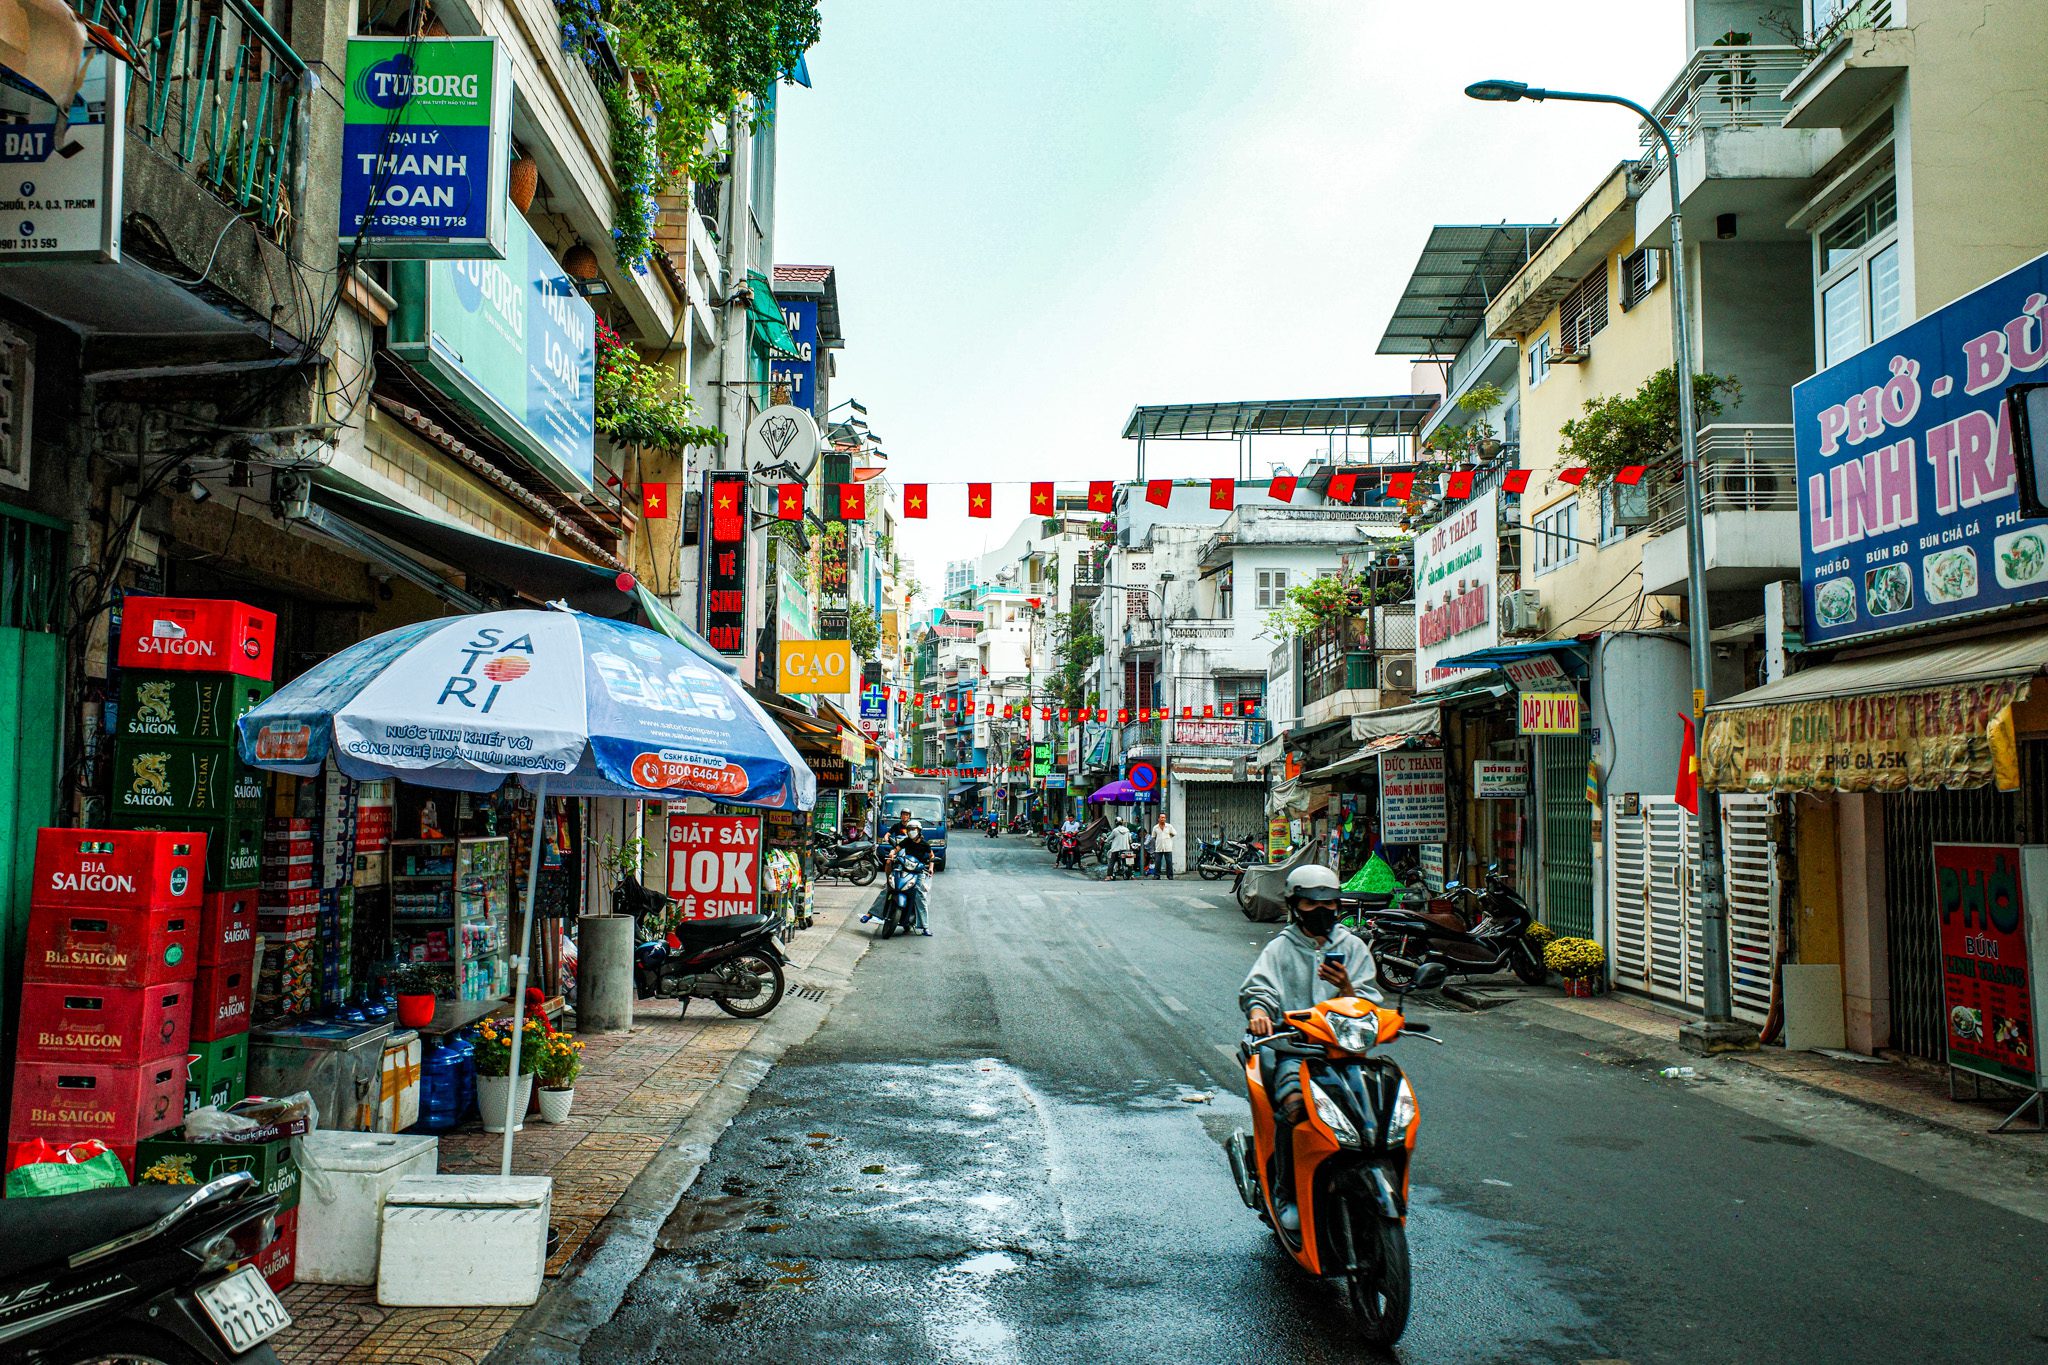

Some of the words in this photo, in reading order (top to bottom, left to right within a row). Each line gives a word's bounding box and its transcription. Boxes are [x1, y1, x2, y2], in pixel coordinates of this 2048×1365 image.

[375, 72, 478, 98] TUBORG
[5, 132, 47, 161] ĐẠT
[388, 131, 417, 147] ĐẠI
[421, 129, 440, 145] LÝ
[357, 153, 467, 176] THANH
[64, 198, 96, 209] TP.HCM
[370, 184, 454, 208] LOAN
[381, 215, 417, 227] 0908
[421, 216, 440, 227] 911
[21, 238, 38, 248] 313
[40, 238, 58, 248] 593
[539, 269, 584, 355] THANH
[545, 330, 580, 400] LOAN
[1817, 354, 1921, 458] PHỞ
[1809, 436, 1919, 554] LINH
[1432, 526, 1447, 557] ĐỨC
[1449, 508, 1478, 545] THÀNH
[1919, 531, 1940, 550] BÚN
[1965, 518, 1980, 537] CÁ
[1866, 546, 1889, 564] BÚN
[1892, 539, 1909, 556] BÒ
[1814, 558, 1834, 579] PHỞ
[1834, 556, 1850, 573] BÒ
[710, 590, 743, 613] SINH
[138, 636, 213, 656] SAIGON
[785, 652, 845, 684] GẠO
[437, 676, 502, 714] RI
[200, 682, 213, 736] SPECIAL
[1522, 694, 1542, 732] DẬP
[1543, 699, 1555, 729] LY
[1556, 694, 1577, 729] MÁY
[128, 723, 177, 735] SAIGON
[1834, 697, 1898, 744] LINH
[386, 725, 428, 740] NƯỚC
[429, 727, 462, 742] TINH
[464, 731, 506, 749] KHIẾT
[508, 736, 533, 751] VỚI
[349, 741, 390, 756] CÔNG
[392, 743, 431, 761] NGHỆ
[432, 746, 473, 761] HOÀN
[474, 751, 503, 765] LƯU
[504, 753, 566, 772] KHOÁNG
[663, 752, 682, 762] CSKH
[703, 757, 722, 768] NƯỚC
[820, 755, 845, 769] BÁNH
[1384, 755, 1406, 772] ĐỨC
[1408, 754, 1443, 771] THÀNH
[1744, 752, 1768, 773] PHỞ
[1785, 754, 1811, 771] 30K
[1825, 748, 1850, 771] PHỞ
[1855, 749, 1874, 770] GÀ
[1878, 751, 1909, 769] 25K
[196, 755, 209, 808] SPECIAL
[244, 776, 253, 784] BIA
[662, 764, 691, 776] 1800
[692, 767, 719, 781] 6464
[721, 771, 736, 783] 77
[124, 795, 173, 806] SAIGON
[141, 787, 156, 795] BIA
[234, 785, 262, 798] SAIGON
[669, 822, 714, 848] GIẶT
[240, 847, 250, 855] BIA
[81, 862, 106, 873] BIA
[230, 855, 258, 870] SAIGON
[51, 872, 133, 893] SAIGON
[1939, 853, 2020, 936] PHỞ
[703, 899, 753, 917] SINH
[223, 928, 251, 944] SAIGON
[233, 921, 243, 929] BIA
[1965, 932, 1999, 960] BÚN
[45, 950, 69, 964] Bia
[71, 951, 127, 967] SAIGON
[1977, 960, 2026, 989] TRANG
[219, 1001, 246, 1019] SAIGON
[229, 995, 238, 1004] BIA
[38, 1032, 63, 1046] Bia
[65, 1034, 122, 1048] SAIGON
[31, 1108, 55, 1122] Bia
[58, 1109, 116, 1124] SAIGON
[234, 1131, 257, 1141] Dark
[258, 1127, 280, 1138] Fruit
[267, 1171, 297, 1195] SAIGON
[278, 1166, 288, 1178] BIA
[263, 1252, 292, 1279] SAIGON
[272, 1249, 282, 1260] BIA
[222, 1298, 286, 1348] 212.62
